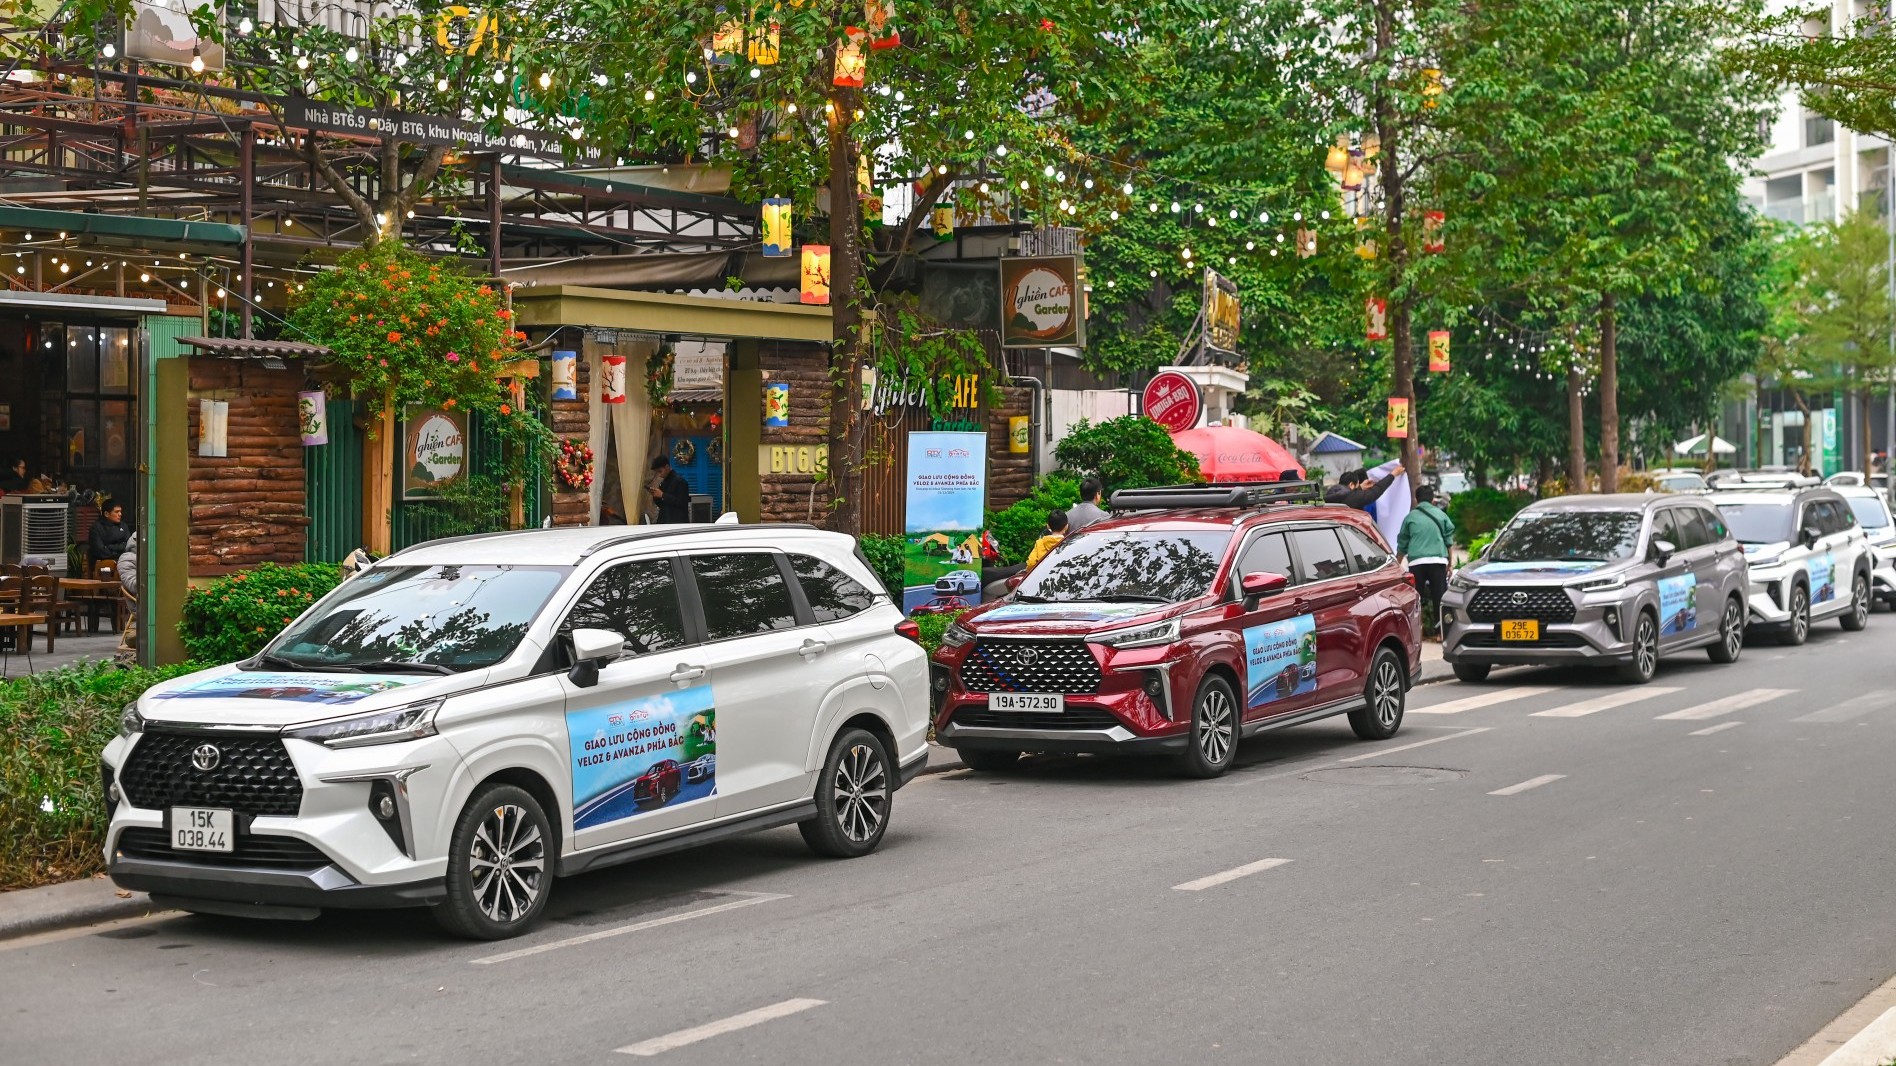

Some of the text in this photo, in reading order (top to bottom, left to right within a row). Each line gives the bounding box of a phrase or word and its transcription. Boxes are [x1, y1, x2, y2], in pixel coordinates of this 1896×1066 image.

[304, 108, 329, 124] Nhà
[332, 111, 366, 129] BT6.9
[377, 117, 399, 136] Dãy
[402, 121, 426, 139] BT6,
[428, 123, 450, 139] khu
[452, 127, 482, 147] Ngoại
[509, 135, 537, 154] đn,
[1034, 303, 1069, 315] Garden
[943, 373, 978, 408] AFE
[1149, 385, 1191, 420] UMIGA-BBQ
[432, 452, 462, 465] Garden
[1512, 621, 1528, 630] 29E
[584, 720, 676, 751] GIAO LƯU CỘNG ĐỒNG
[577, 732, 685, 768] VELOZ & AVANZA PHÍA BẮC
[190, 810, 215, 828] 15K
[178, 829, 226, 848] 038.44
